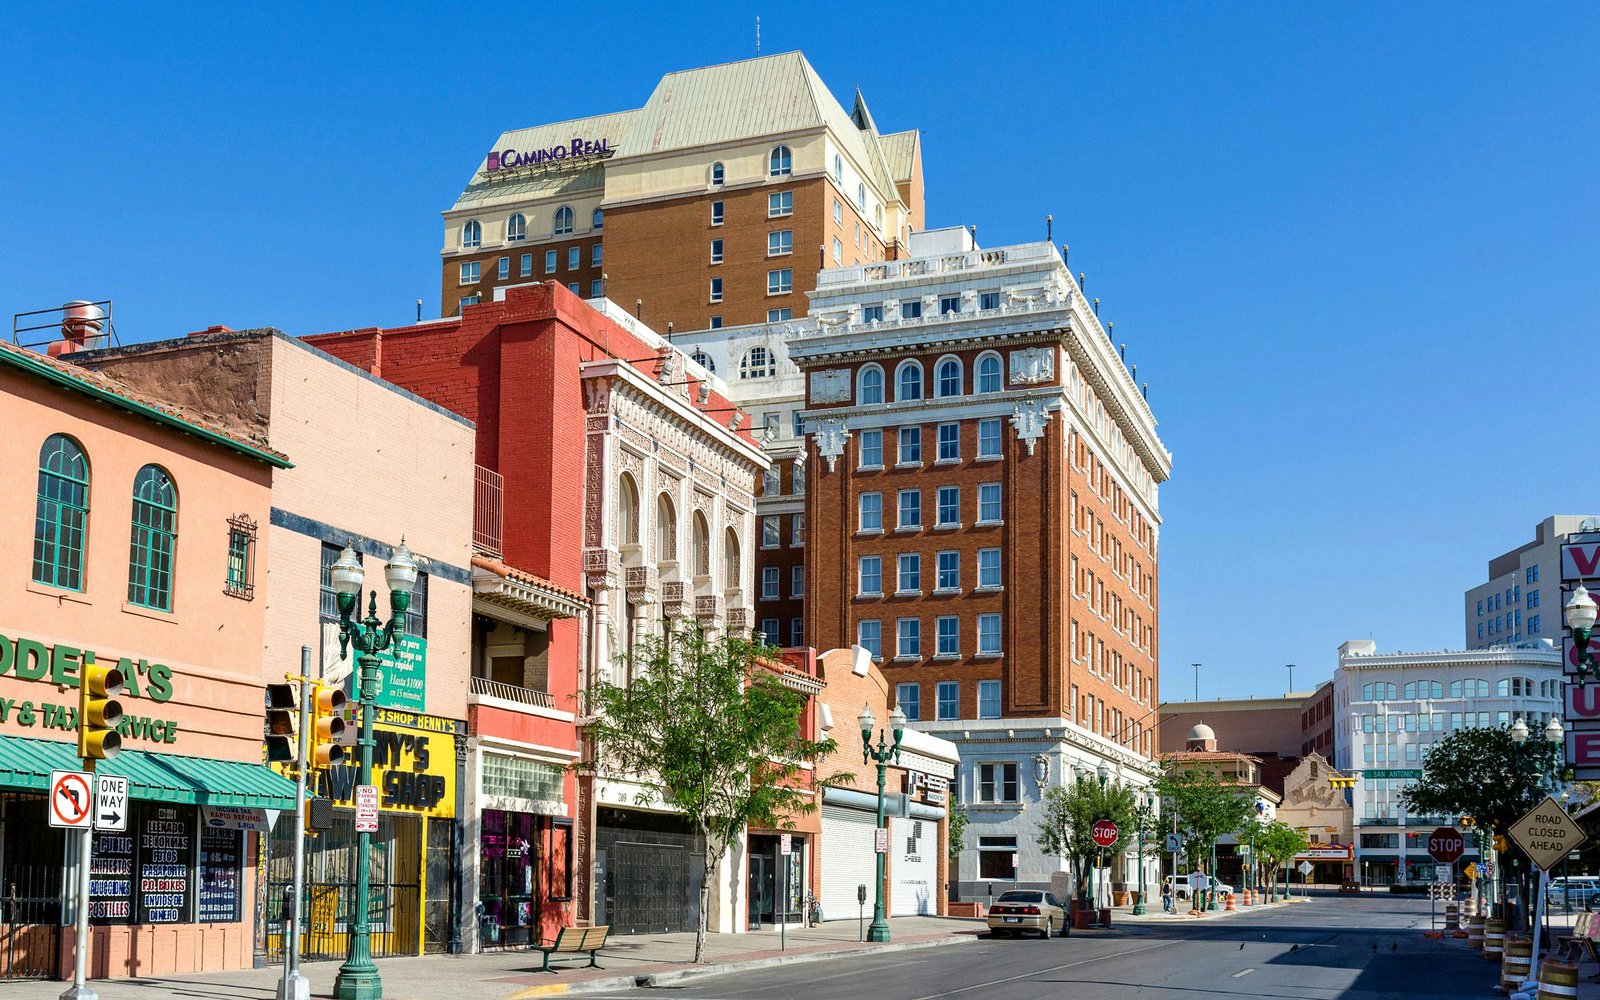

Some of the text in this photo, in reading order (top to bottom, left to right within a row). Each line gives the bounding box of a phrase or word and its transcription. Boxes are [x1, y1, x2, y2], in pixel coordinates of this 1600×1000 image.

[501, 138, 611, 168] CAMINO REAL
[389, 673, 406, 687] Hasta
[17, 701, 37, 728] &
[386, 711, 414, 726] SHOP
[417, 717, 456, 734] BENNY'S
[1372, 770, 1386, 778] SAN
[101, 779, 124, 794] ONE
[382, 770, 446, 810] SHOP
[100, 794, 124, 809] WAY
[1535, 814, 1562, 825] ROAD
[1093, 827, 1117, 839] STOP
[1528, 827, 1566, 838] CLOSED
[1430, 838, 1462, 852] STOP
[1529, 841, 1563, 852] AHEAD
[157, 879, 187, 892] BOXES
